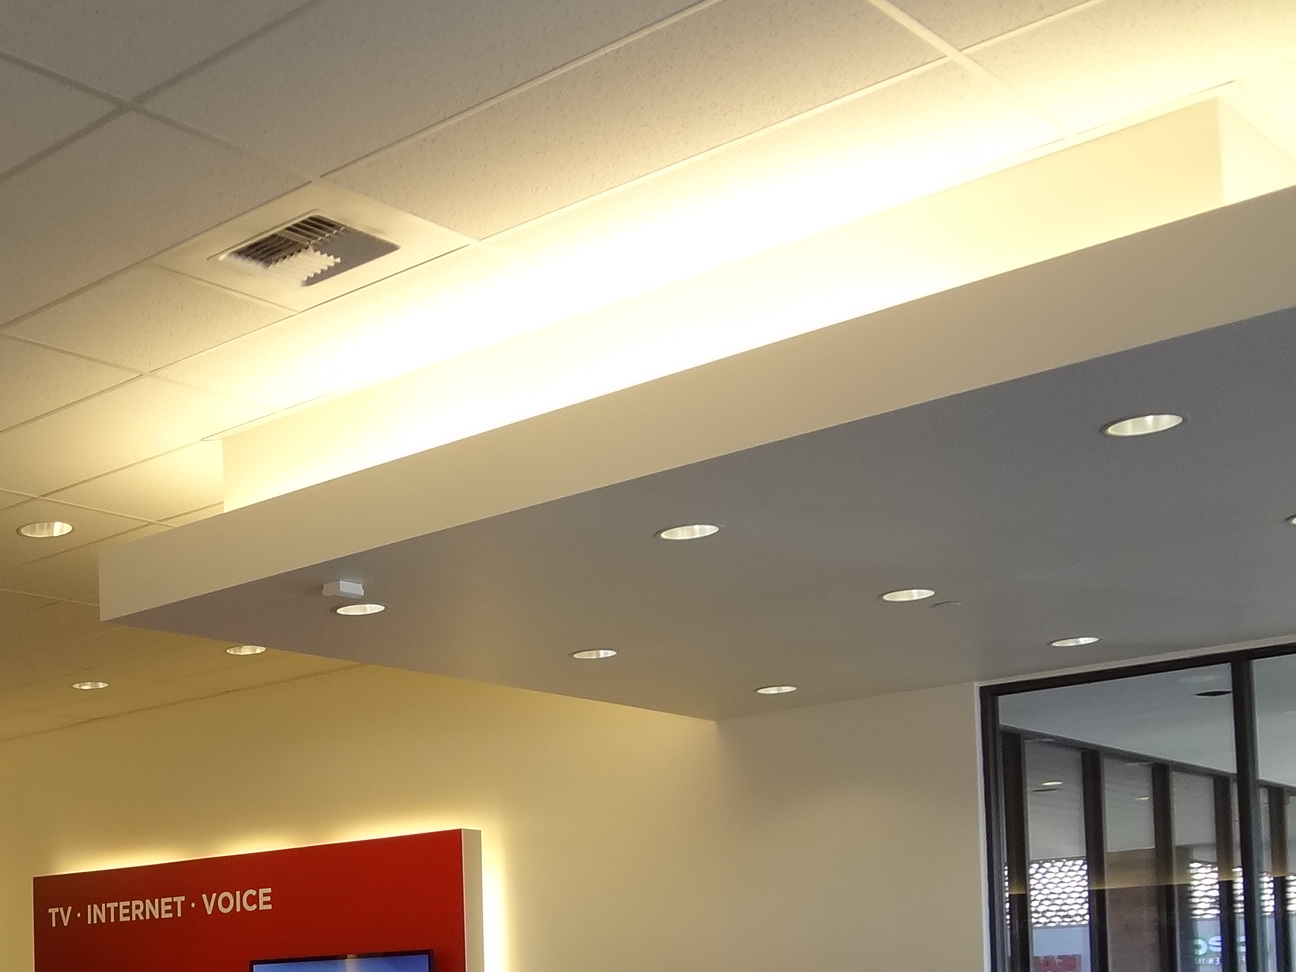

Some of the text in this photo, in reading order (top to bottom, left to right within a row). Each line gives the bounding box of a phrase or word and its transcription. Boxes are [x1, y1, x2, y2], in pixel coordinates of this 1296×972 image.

[49, 887, 272, 928] TV INTERNET VOICE
